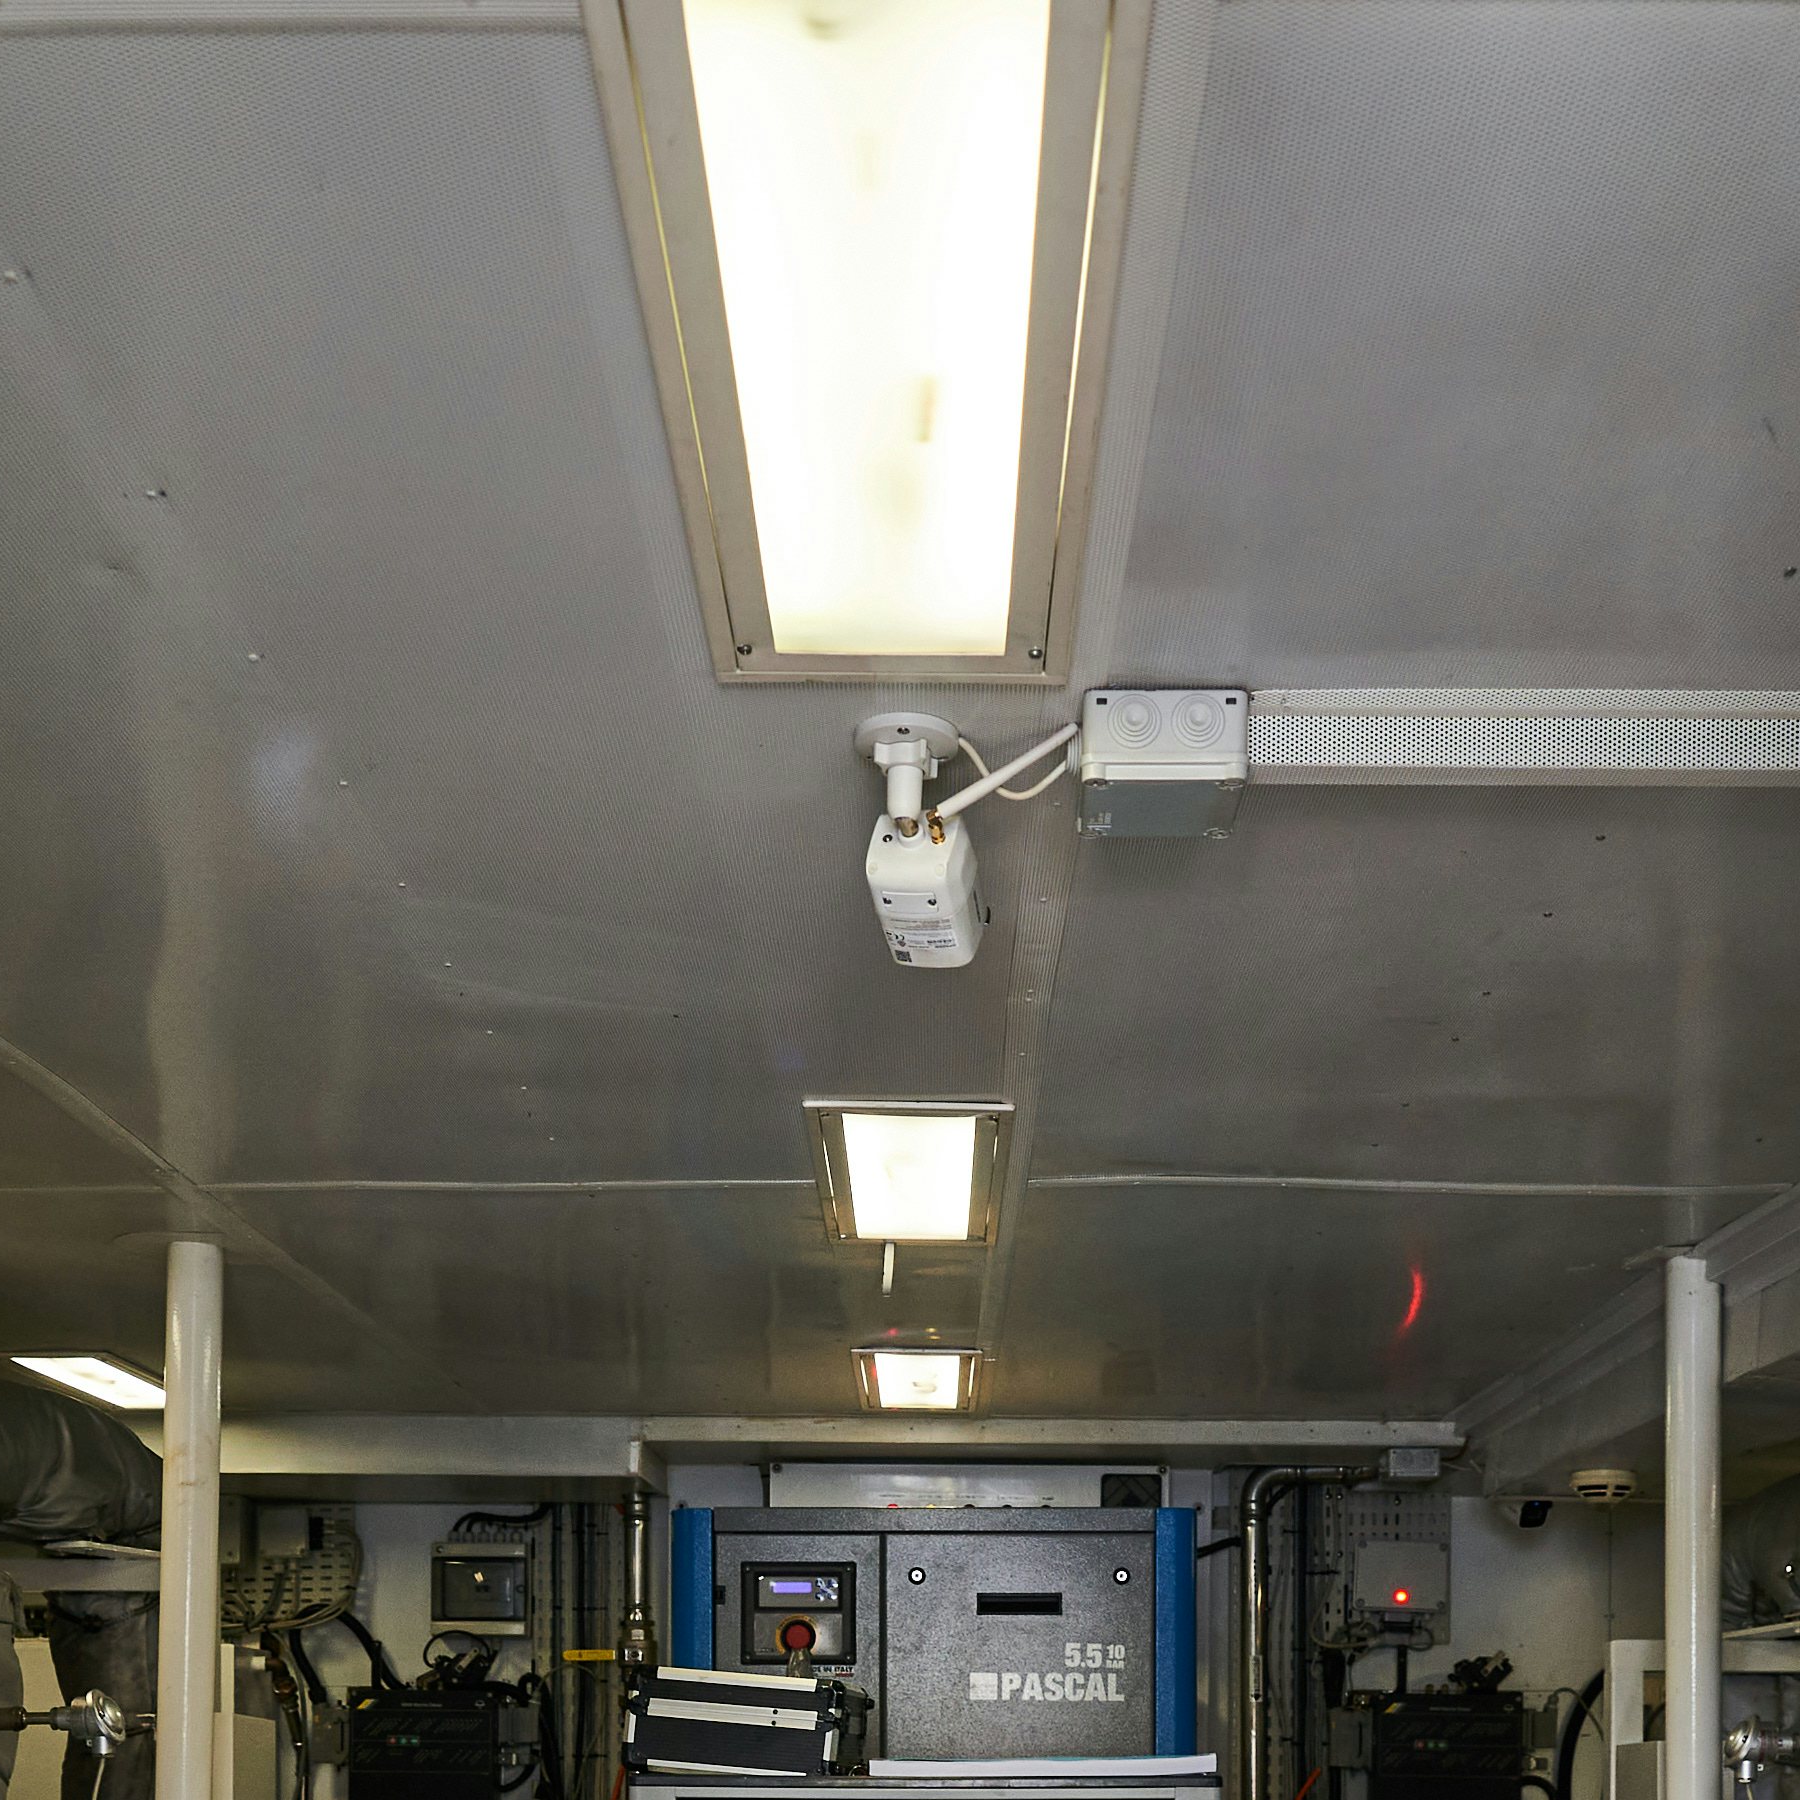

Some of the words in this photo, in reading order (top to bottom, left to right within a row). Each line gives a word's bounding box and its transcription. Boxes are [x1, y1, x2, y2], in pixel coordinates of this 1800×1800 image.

[1064, 1642, 1103, 1669] 5.5
[1106, 1644, 1126, 1660] 10
[1001, 1672, 1125, 1701] PASCAL
